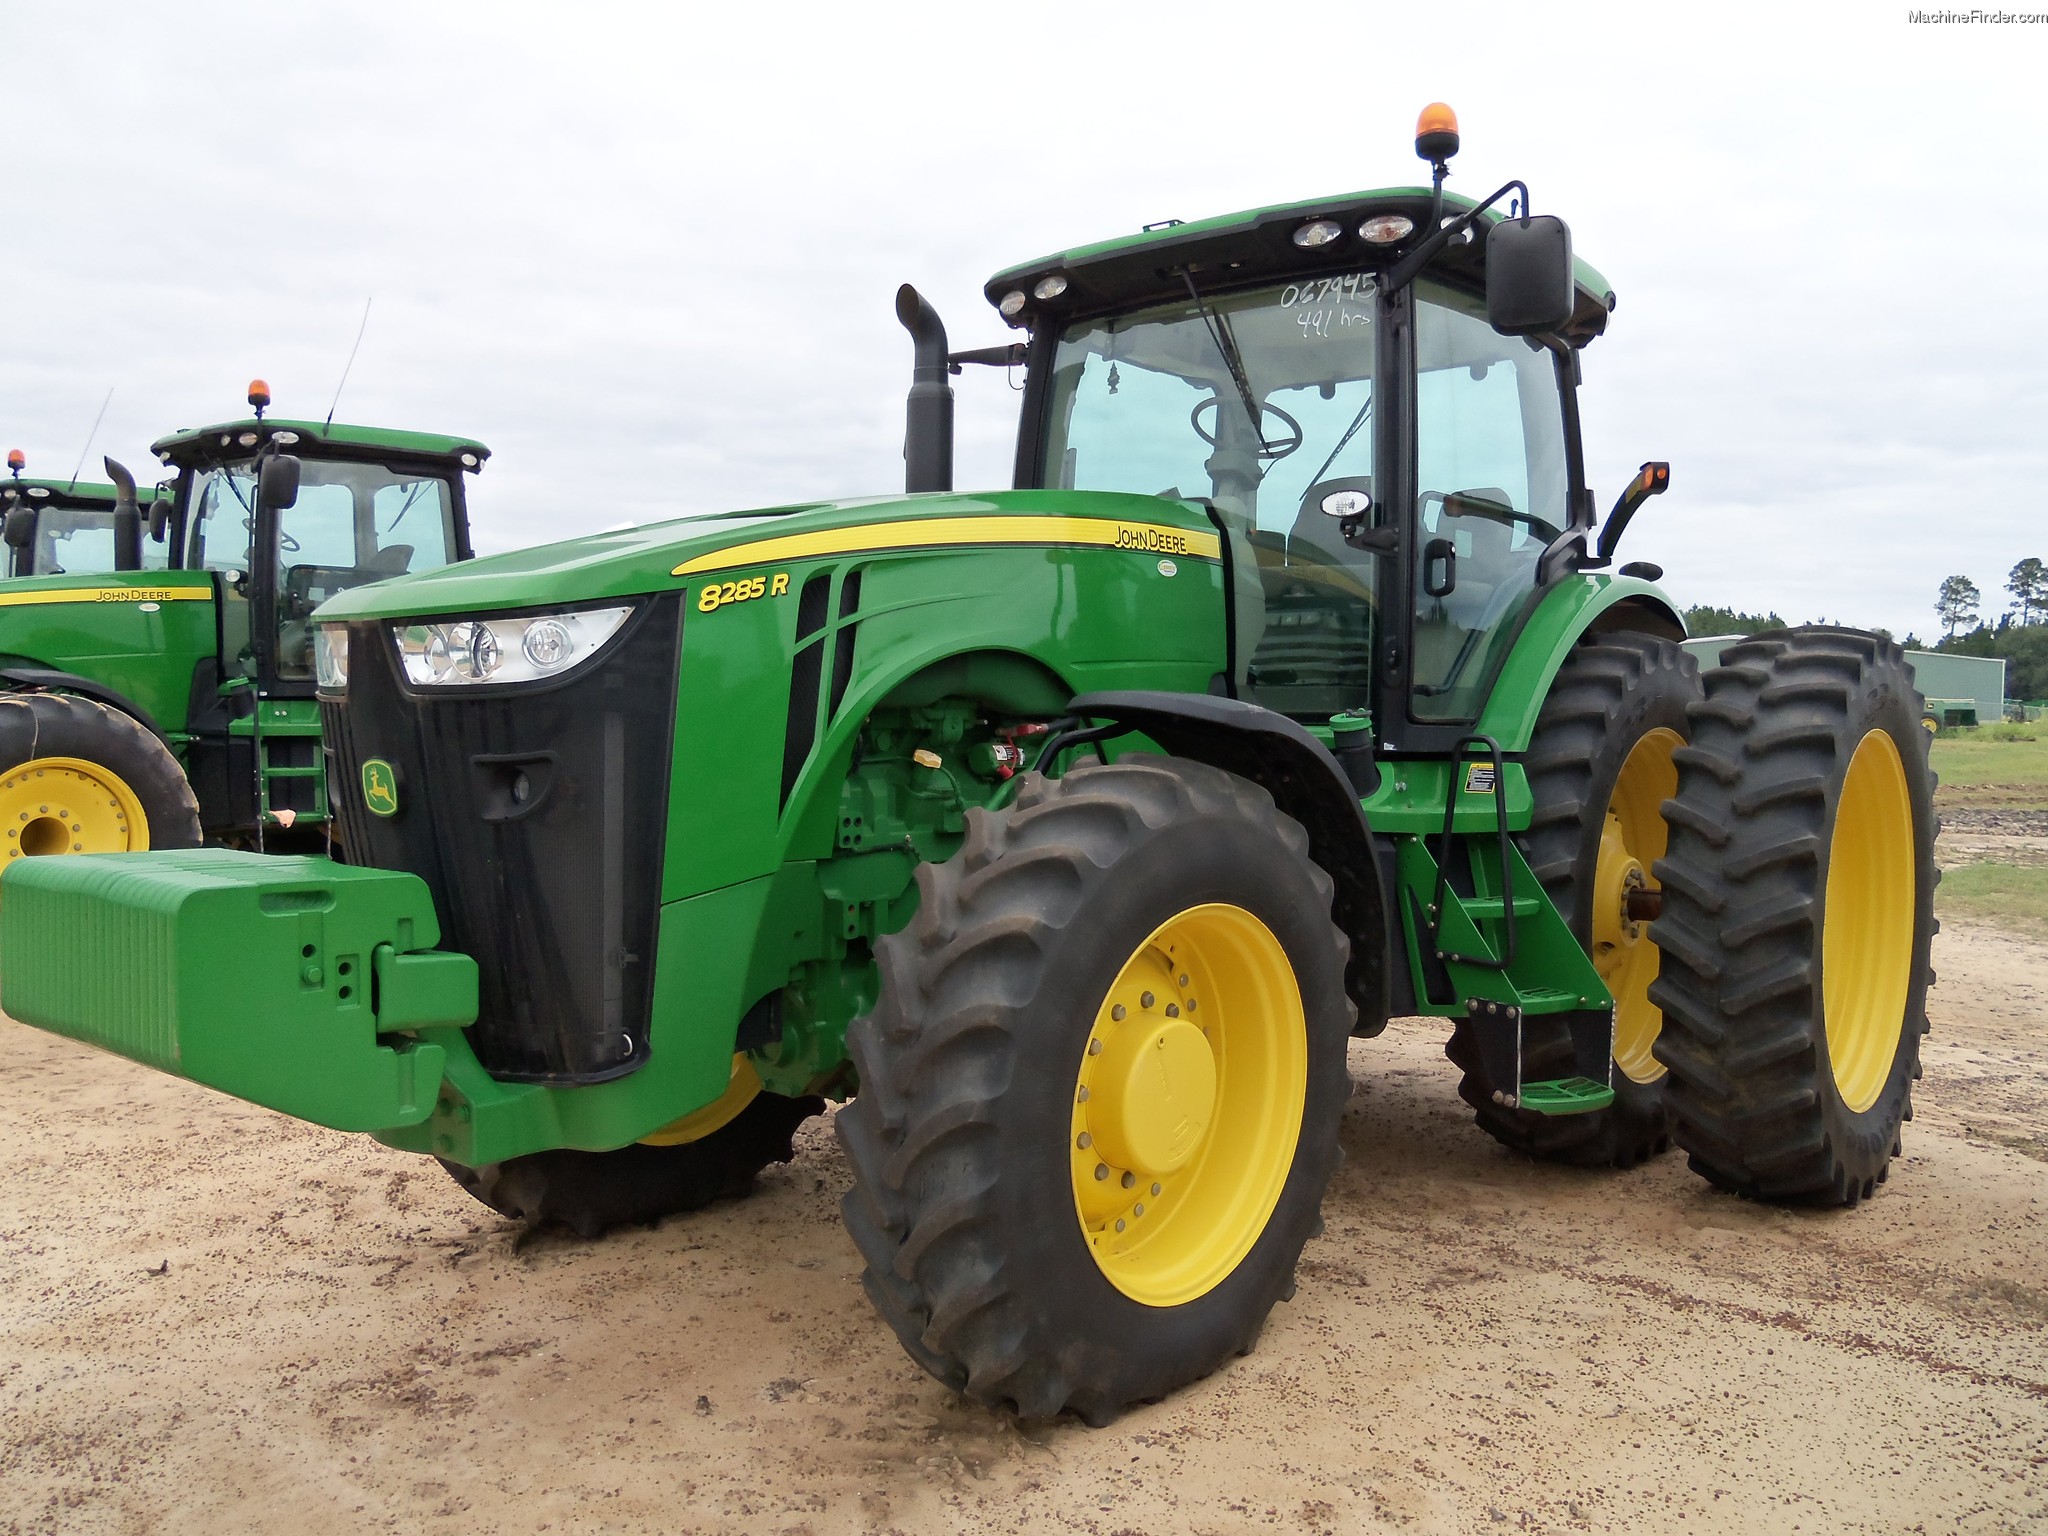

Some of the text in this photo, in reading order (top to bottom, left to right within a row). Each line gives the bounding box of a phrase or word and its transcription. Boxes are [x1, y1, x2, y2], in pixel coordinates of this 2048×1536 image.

[1280, 272, 1377, 309] 067945
[1297, 308, 1371, 338] 491 hrs
[698, 573, 789, 613] 8285 R
